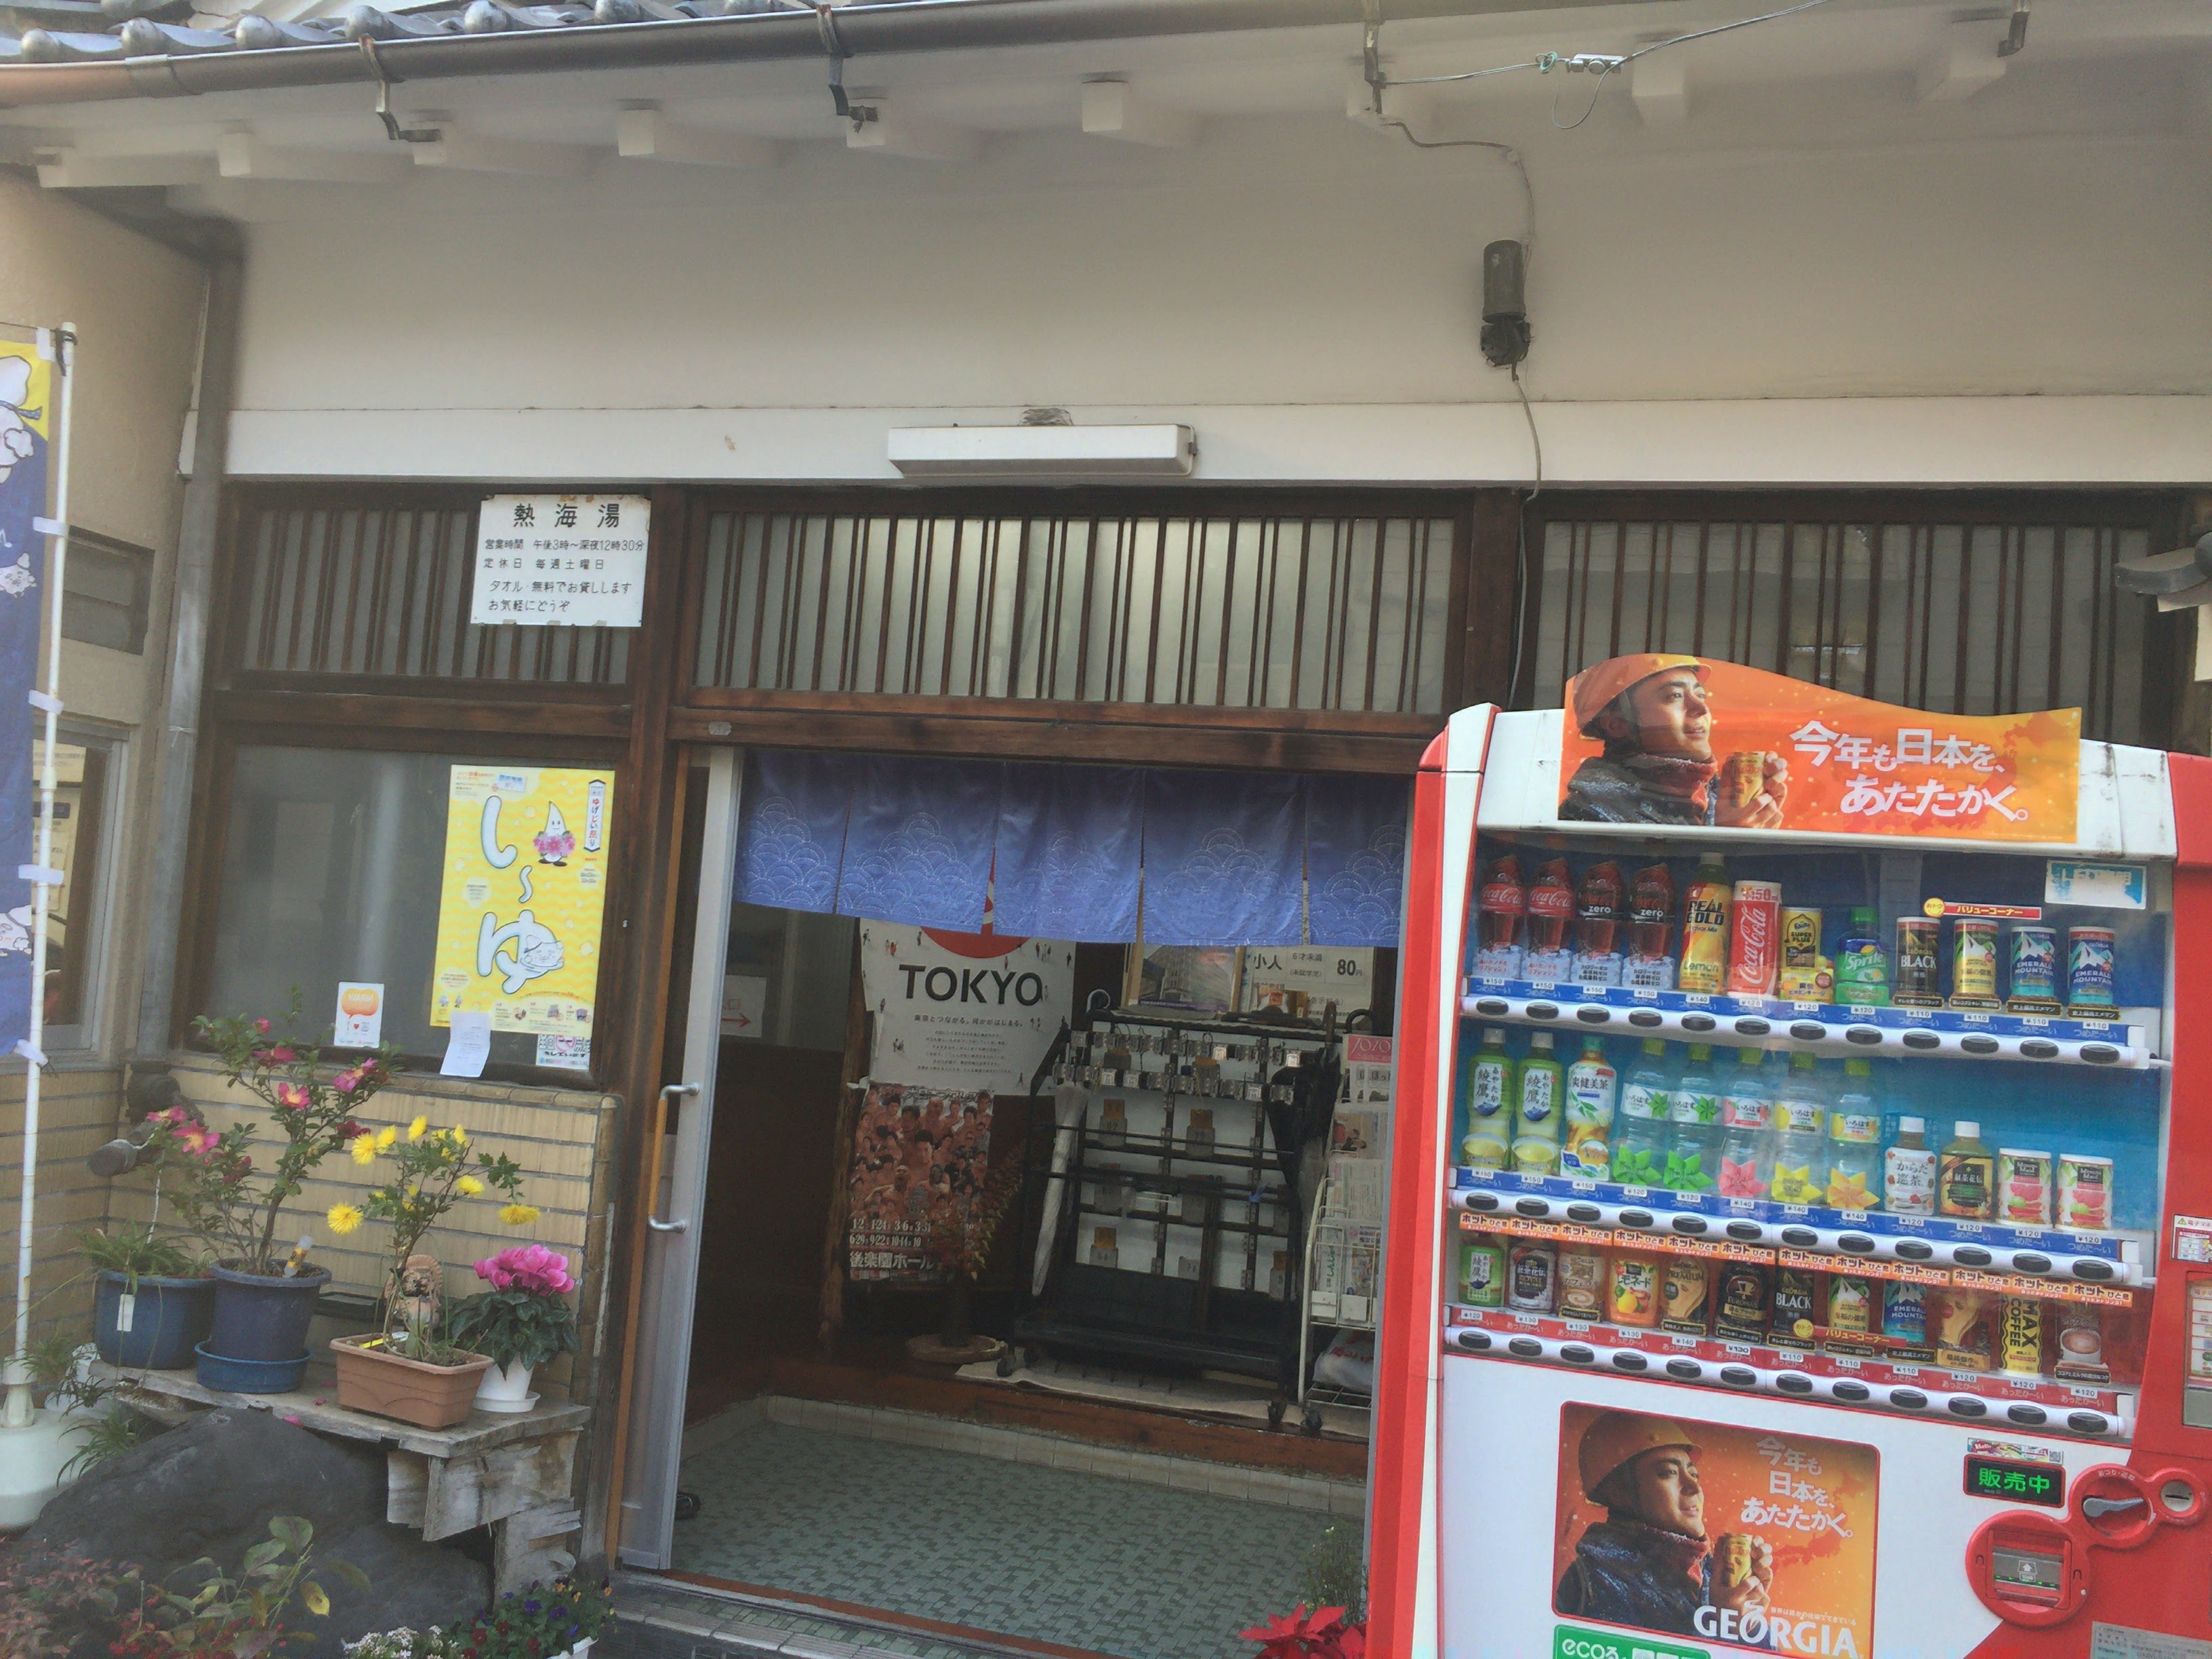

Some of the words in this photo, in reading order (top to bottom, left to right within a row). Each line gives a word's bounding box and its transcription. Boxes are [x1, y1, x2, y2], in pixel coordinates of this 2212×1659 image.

[514, 503, 620, 528] 熱海湯
[485, 539, 523, 550] 営業時間
[483, 558, 522, 569] 定休日
[535, 558, 604, 570] 毎週土曜日
[489, 580, 523, 592] タオル
[531, 581, 632, 594] 無料でお貸しします
[488, 600, 571, 612] お気軽にどうぞ
[1788, 720, 2007, 774] 今年も日本を、
[1840, 773, 2029, 822] あたたかく。
[1589, 904, 1612, 914] zero
[1640, 908, 1664, 918] zero
[1687, 899, 1725, 914] REAL
[1957, 905, 2024, 916] バリューコーナー
[1686, 912, 1725, 925] GOLD
[1254, 953, 1282, 970] 小人
[1683, 960, 1719, 972] Lemon
[1845, 951, 1884, 971] Sprite
[1901, 955, 1937, 970] BLACK
[2016, 960, 2052, 970] EMERALD
[2014, 967, 2053, 977] MOUNTAIN
[2075, 970, 2112, 979] EMERALD
[899, 964, 1043, 1006] TOKYO
[2073, 976, 2112, 985] MOUNTAIN
[1476, 1068, 1491, 1099] 綾鷹
[1491, 1066, 1499, 1102] あやたか
[1525, 1074, 1542, 1104] 綾鷹
[1540, 1072, 1550, 1107] あやたか
[1572, 1076, 1610, 1090] 爽健美茶
[1736, 1103, 1762, 1113] いろはす
[1790, 1109, 1816, 1118] いろはす
[1897, 1161, 1929, 1175] からだ
[1897, 1173, 1921, 1187] 巡茶
[1617, 1274, 1651, 1288] レモネード
[1668, 1270, 1704, 1282] PREMIUM
[1776, 1292, 1811, 1309] BLACK
[2009, 1297, 2022, 1348] COFFEE
[2022, 1298, 2039, 1349] MAX
[1825, 1328, 1891, 1343] バリューコーナー
[1756, 1435, 1823, 1475] 今年も
[1978, 1467, 2051, 1494] 販売中
[1769, 1470, 1837, 1509] 日本を、
[1740, 1496, 1854, 1538] あたたかく。
[1694, 1600, 1858, 1658] GEORGIA
